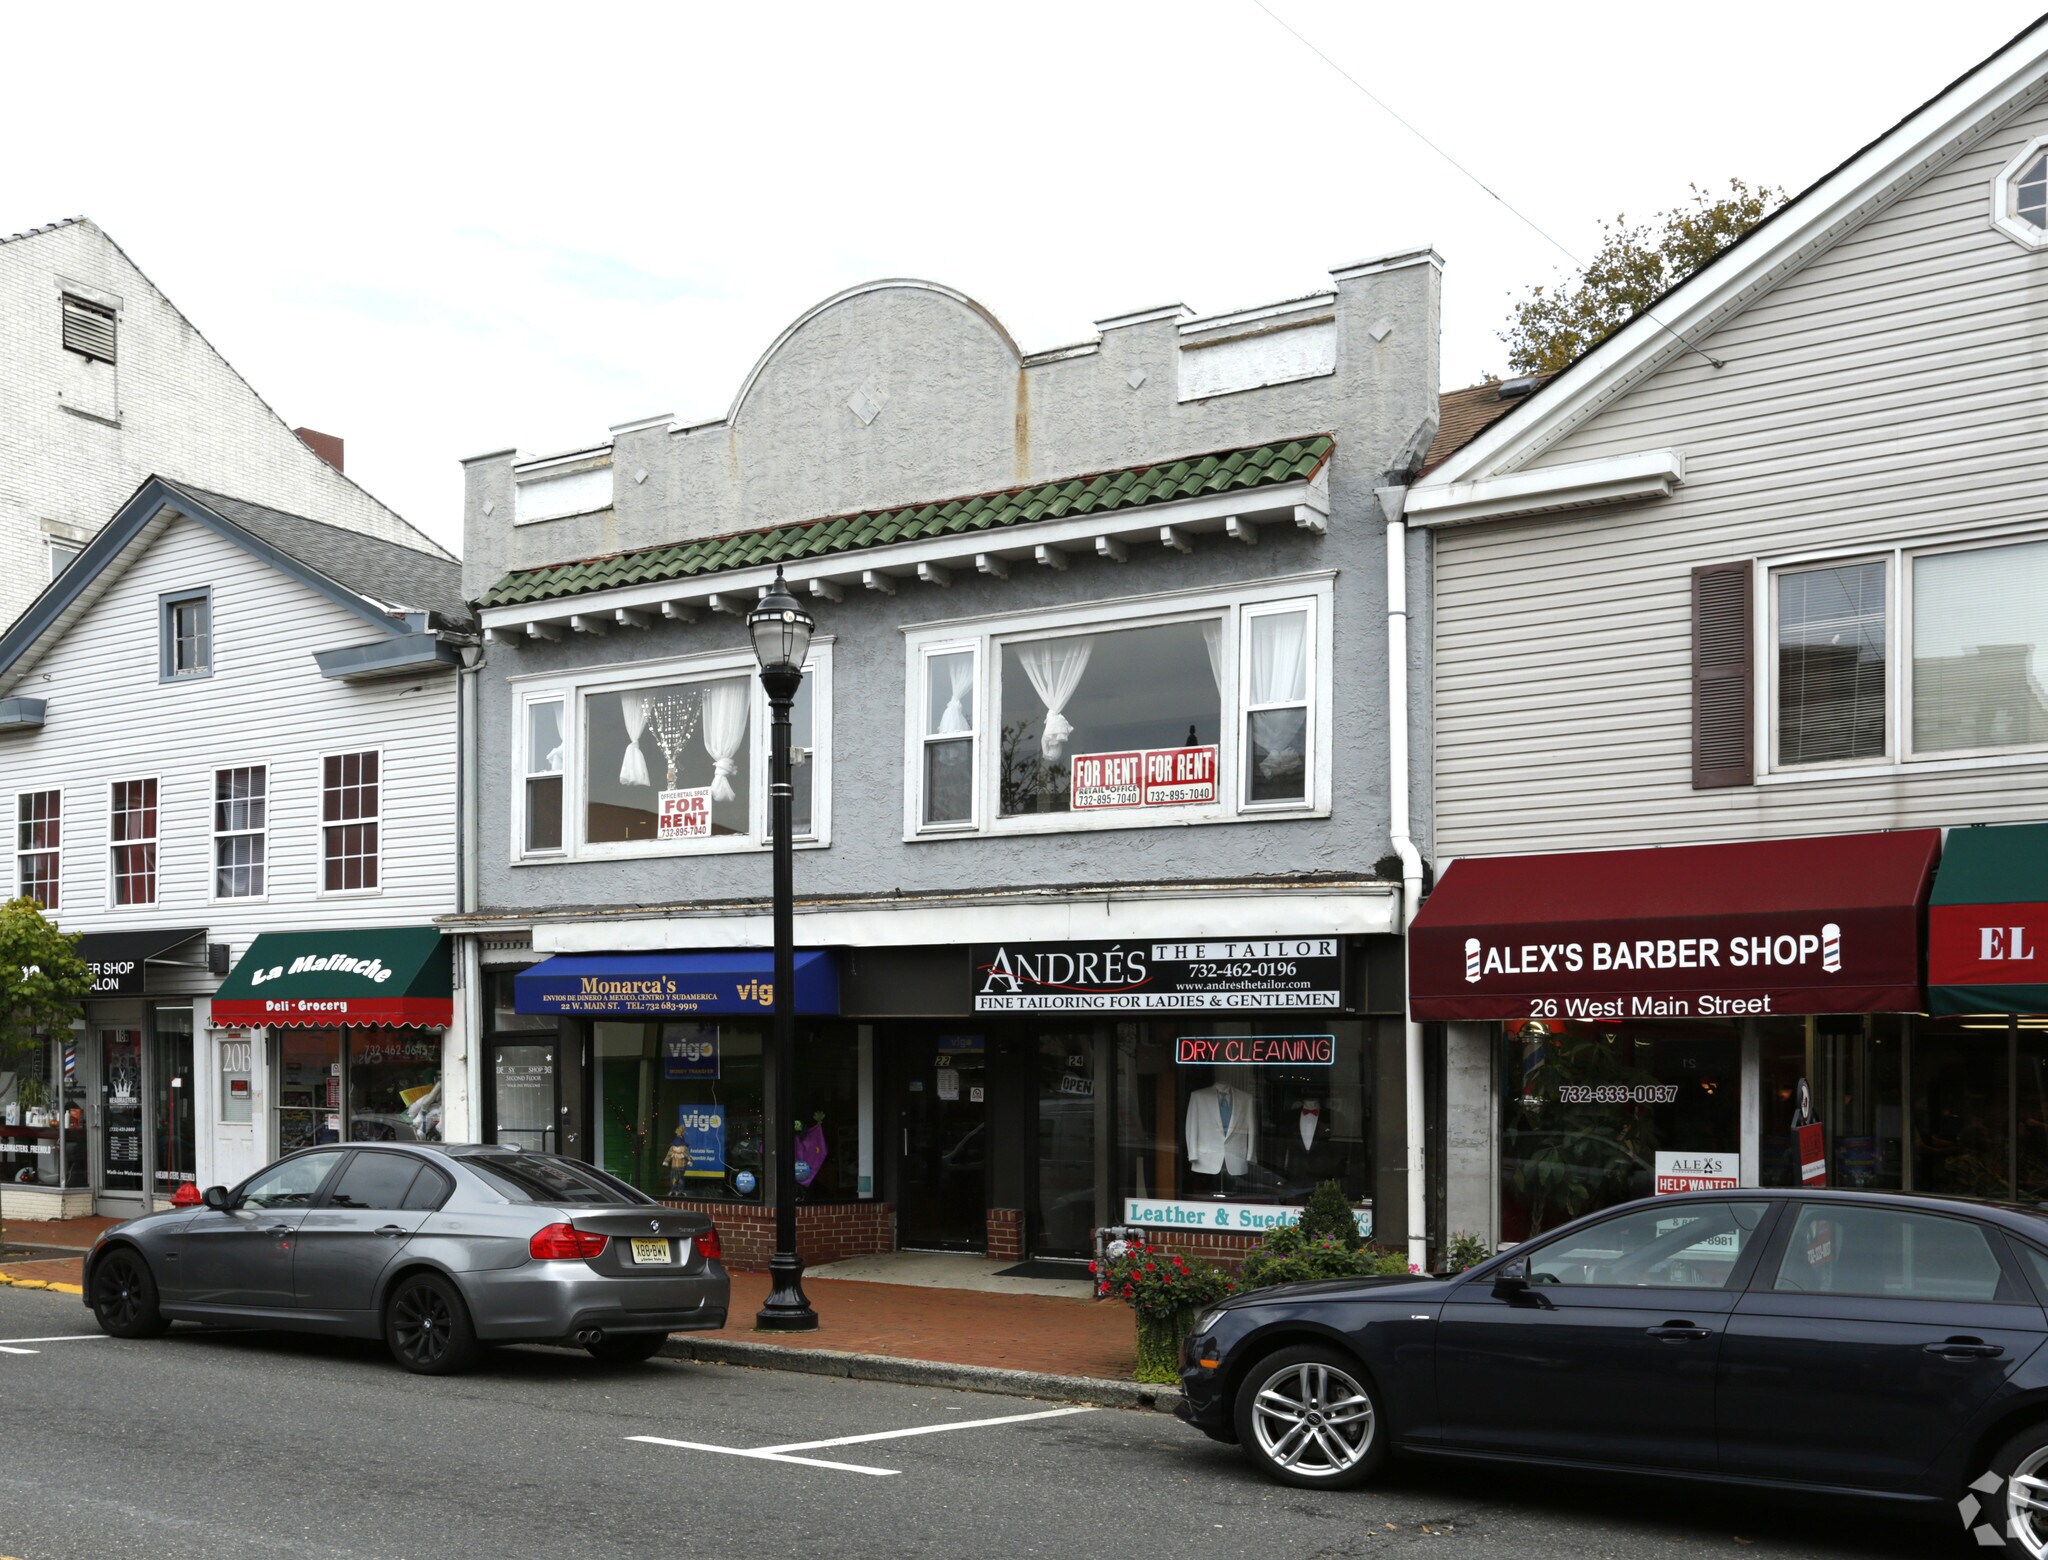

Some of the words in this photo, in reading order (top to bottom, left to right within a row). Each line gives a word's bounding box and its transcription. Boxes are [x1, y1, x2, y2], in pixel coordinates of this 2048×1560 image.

[1077, 760, 1100, 787] FOR
[1105, 757, 1138, 785] RENT
[1148, 755, 1172, 783] FOR
[1177, 752, 1212, 781] RENT
[1079, 793, 1137, 806] 732-895-7040
[1150, 788, 1209, 802] 732-895-7040
[665, 797, 704, 813] FOR
[660, 811, 709, 828] RENT
[662, 826, 706, 838] 732-895-7040
[1156, 944, 1206, 960] THE
[1225, 941, 1332, 958] TAILOR
[1978, 926, 2034, 961] EL
[1483, 943, 1583, 975] ALEX'S
[1593, 938, 1720, 970] BARBER
[1729, 935, 1819, 966] SHOP
[103, 962, 134, 975] SHOP
[251, 965, 284, 986] La
[287, 953, 392, 983] Malinche
[979, 944, 1147, 993] ANDRÉS
[1188, 962, 1297, 978] 732-462-0196
[89, 978, 119, 991] ALON
[580, 975, 677, 994] Monarca's
[736, 979, 774, 1006] vig
[637, 993, 665, 1001] CENTRO
[671, 993, 717, 1001] SUDAMERICA
[980, 997, 1014, 1009] FINE
[1017, 996, 1105, 1009] TAILORING
[1110, 996, 1141, 1008] FOR
[1146, 995, 1204, 1008] LADIES
[1209, 995, 1222, 1008] &
[1226, 993, 1336, 1007] GENTLEMEN
[265, 1000, 289, 1011] Deli
[297, 1000, 347, 1013] Grocery
[570, 1002, 583, 1010] W.
[584, 1002, 606, 1010] MAIN
[607, 1002, 620, 1010] ST.
[645, 1002, 660, 1011] 732
[661, 1001, 697, 1011] 683-9919
[1529, 998, 1558, 1018] 26
[1564, 997, 1623, 1017] West
[1631, 996, 1689, 1016] Main
[1697, 994, 1771, 1015] Street
[222, 1043, 251, 1072] 20B
[669, 1038, 713, 1062] vigo
[1180, 1040, 1220, 1061] DRY
[1225, 1039, 1330, 1062] CLEANING
[935, 1056, 950, 1066] 22
[1070, 1056, 1082, 1066] 24
[1062, 1076, 1092, 1093] OPEN
[1559, 1085, 1678, 1103] 732-333-0037
[682, 1110, 722, 1132] vigo
[1659, 1178, 1687, 1191] HELP
[1131, 1203, 1205, 1224] Leather
[1214, 1207, 1230, 1226] &
